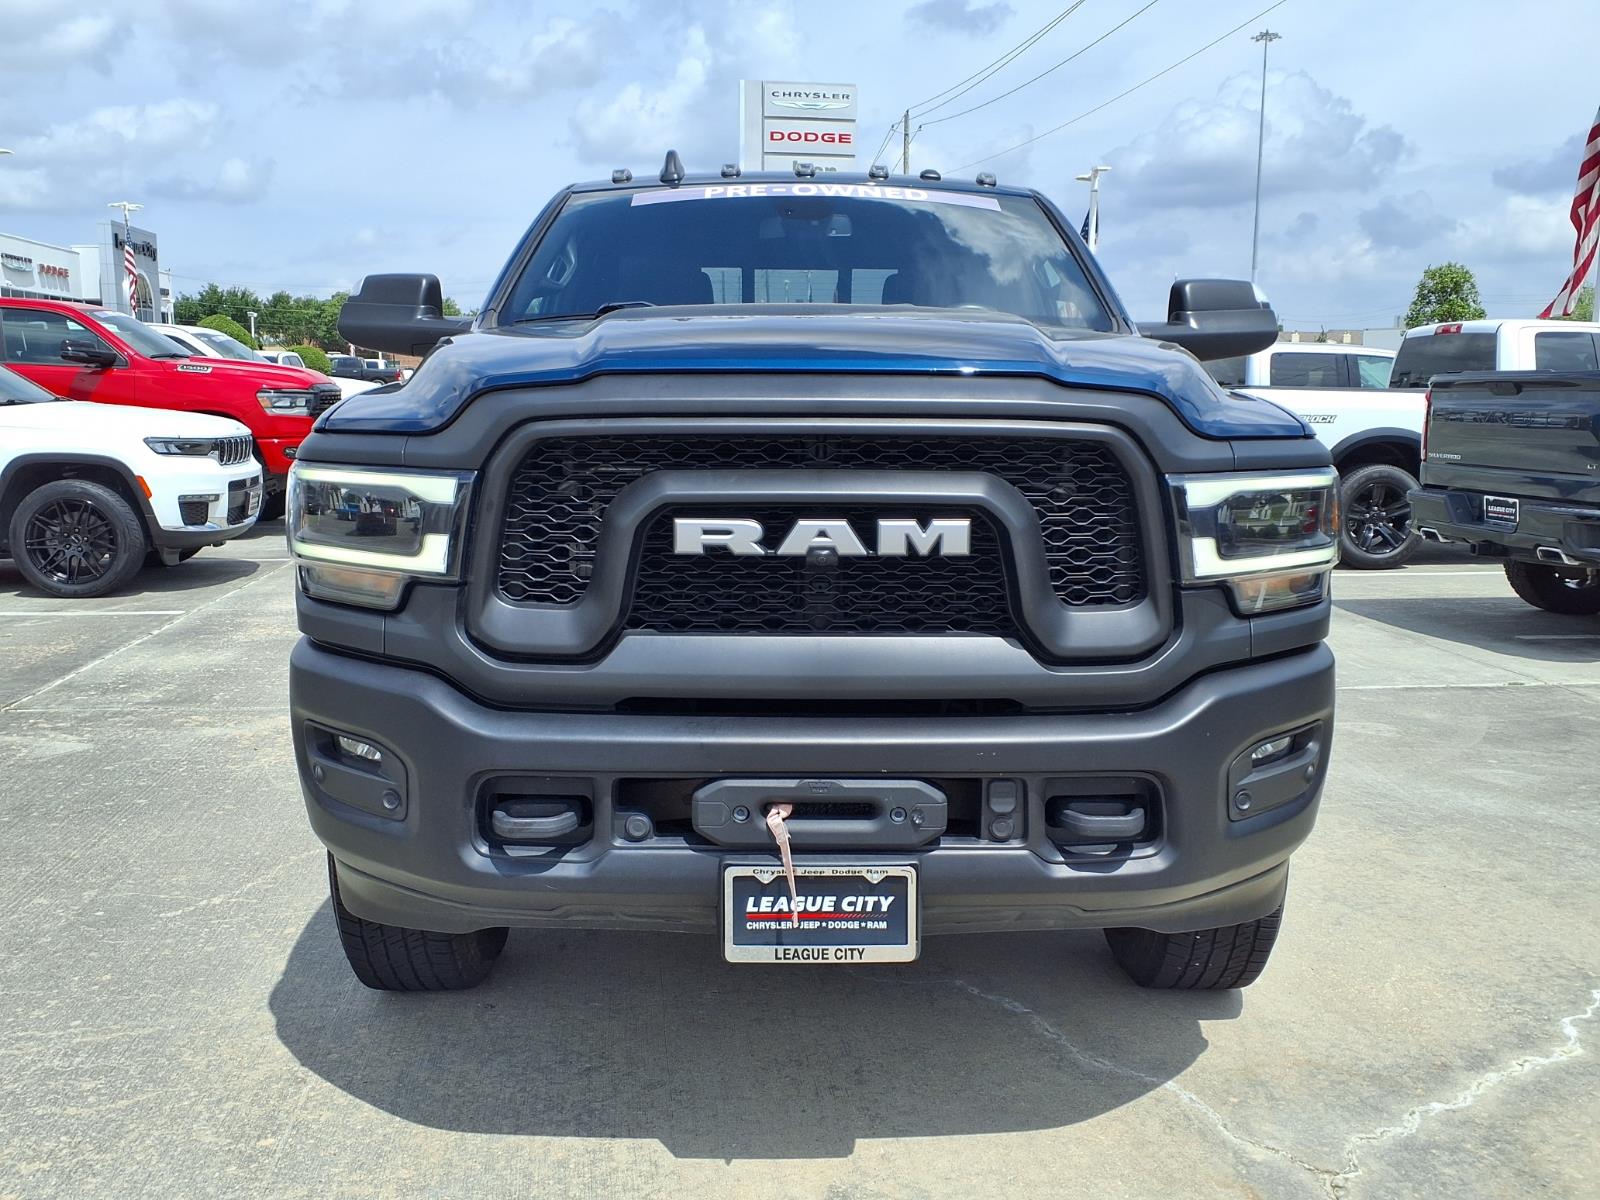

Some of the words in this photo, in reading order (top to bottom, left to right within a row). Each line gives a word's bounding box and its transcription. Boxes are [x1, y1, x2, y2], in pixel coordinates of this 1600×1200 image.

[771, 91, 851, 99] CHRYSLER
[769, 131, 852, 144] DODGE
[39, 264, 69, 278] DODGE
[673, 518, 971, 556] RAM
[746, 896, 836, 912] LEAGUE
[841, 896, 895, 912] CITY
[746, 921, 792, 930] CHRYSLER
[800, 921, 820, 930] JEEP
[828, 921, 859, 930] DODGE
[867, 921, 887, 930] RAM
[775, 948, 829, 960] LEAGUE
[834, 948, 865, 960] CITY
